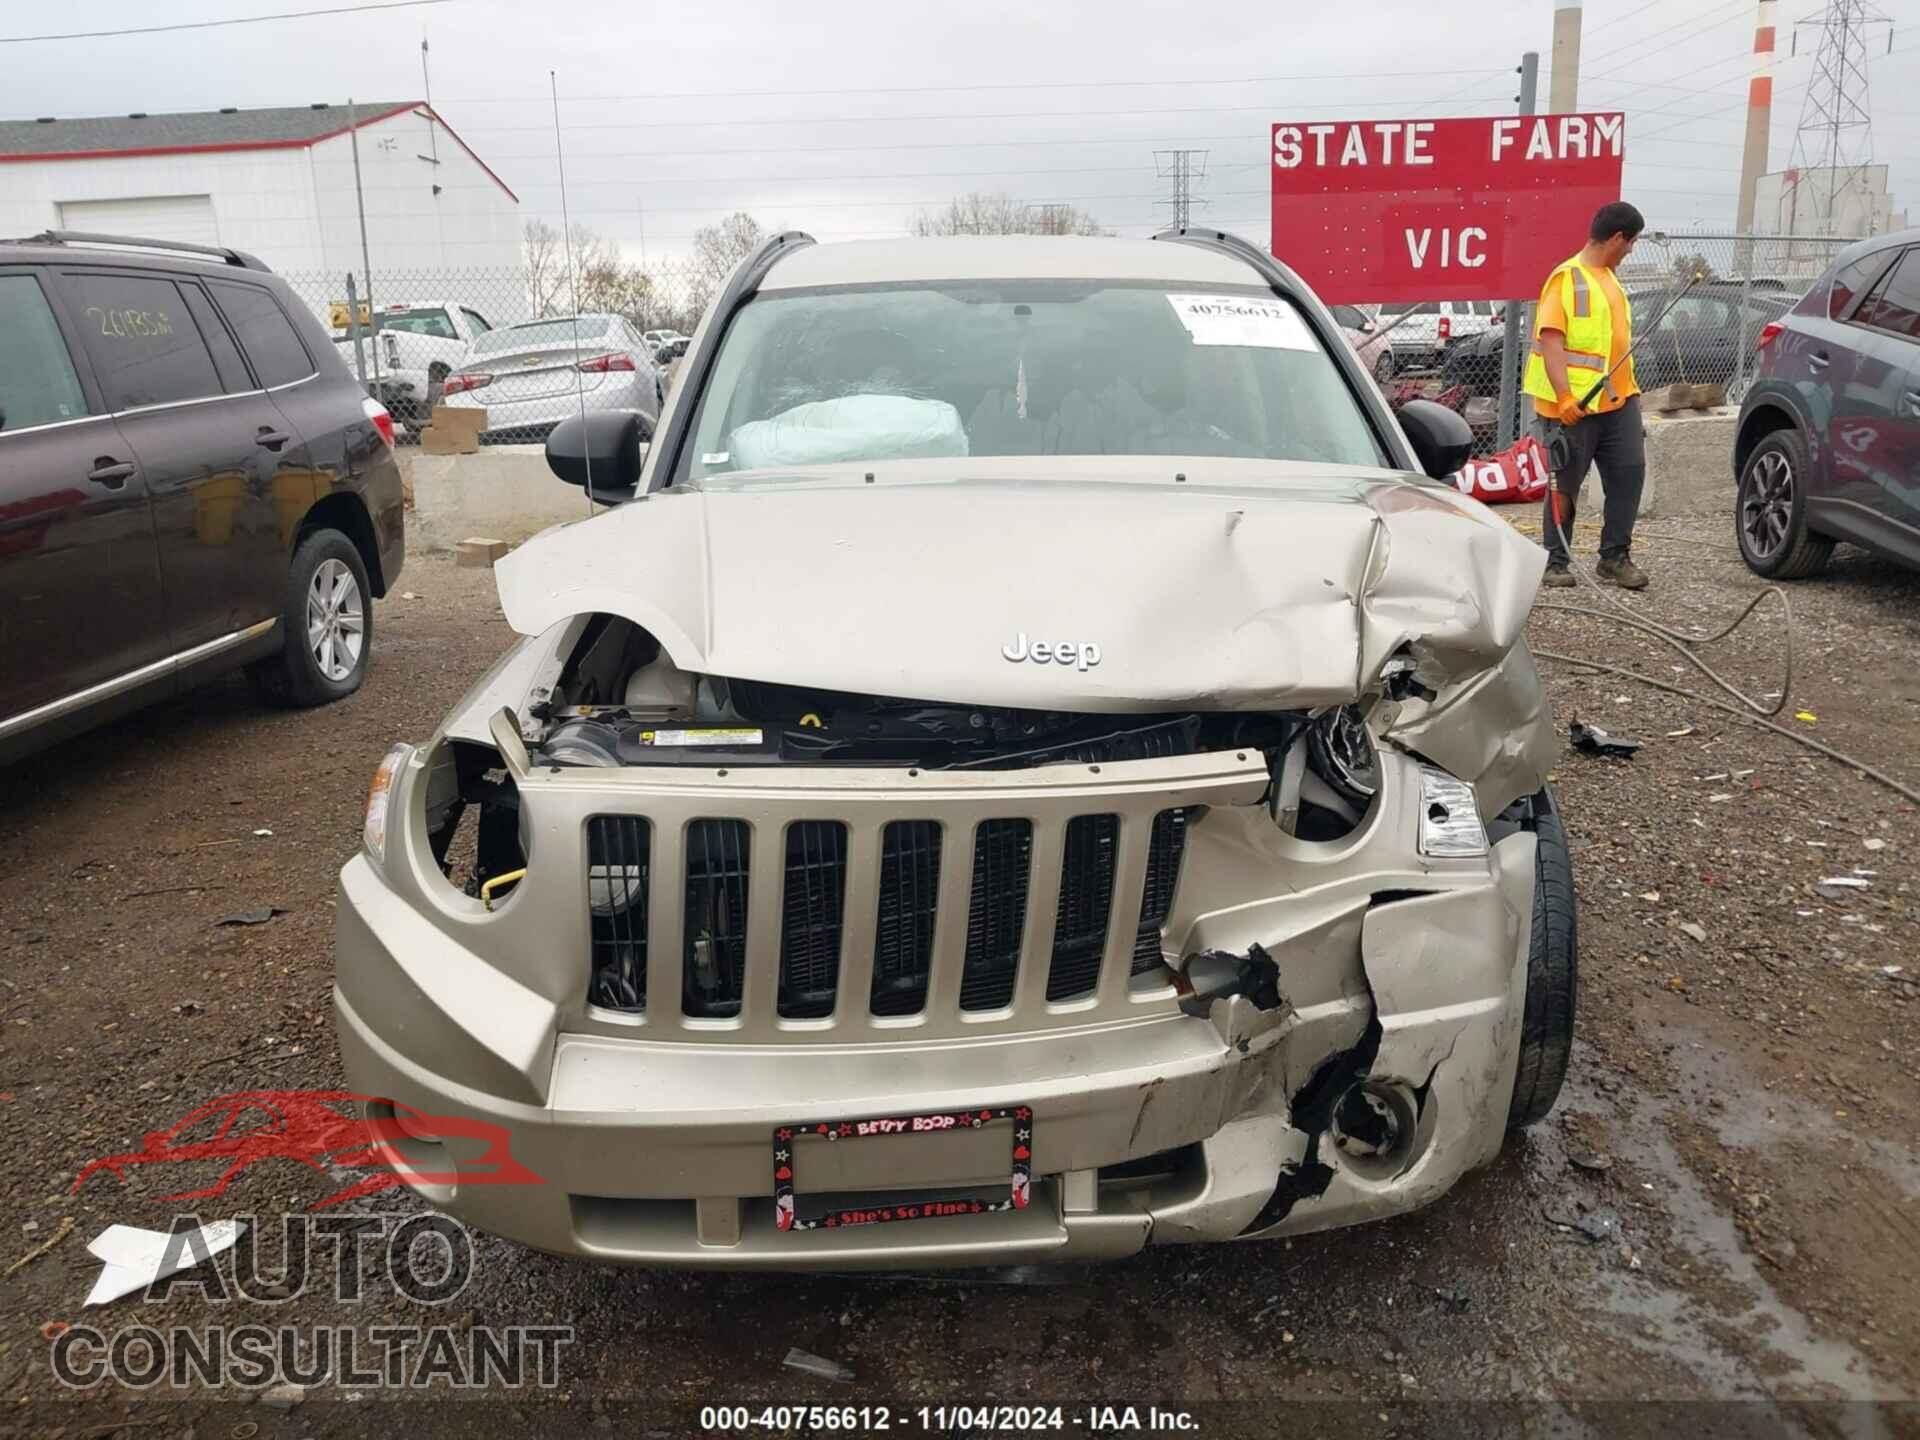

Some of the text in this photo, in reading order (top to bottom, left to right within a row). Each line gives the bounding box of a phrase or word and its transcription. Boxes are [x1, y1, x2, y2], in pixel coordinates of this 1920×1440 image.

[1274, 115, 1622, 168] STATE FARM
[1404, 227, 1488, 268] VIC
[1187, 303, 1286, 319] 40756612
[1001, 632, 1102, 672] Jeep
[856, 1115, 956, 1136] BETTY BOOP
[840, 1208, 891, 1225] She's
[896, 1205, 919, 1218] So
[923, 1200, 968, 1216] Fine
